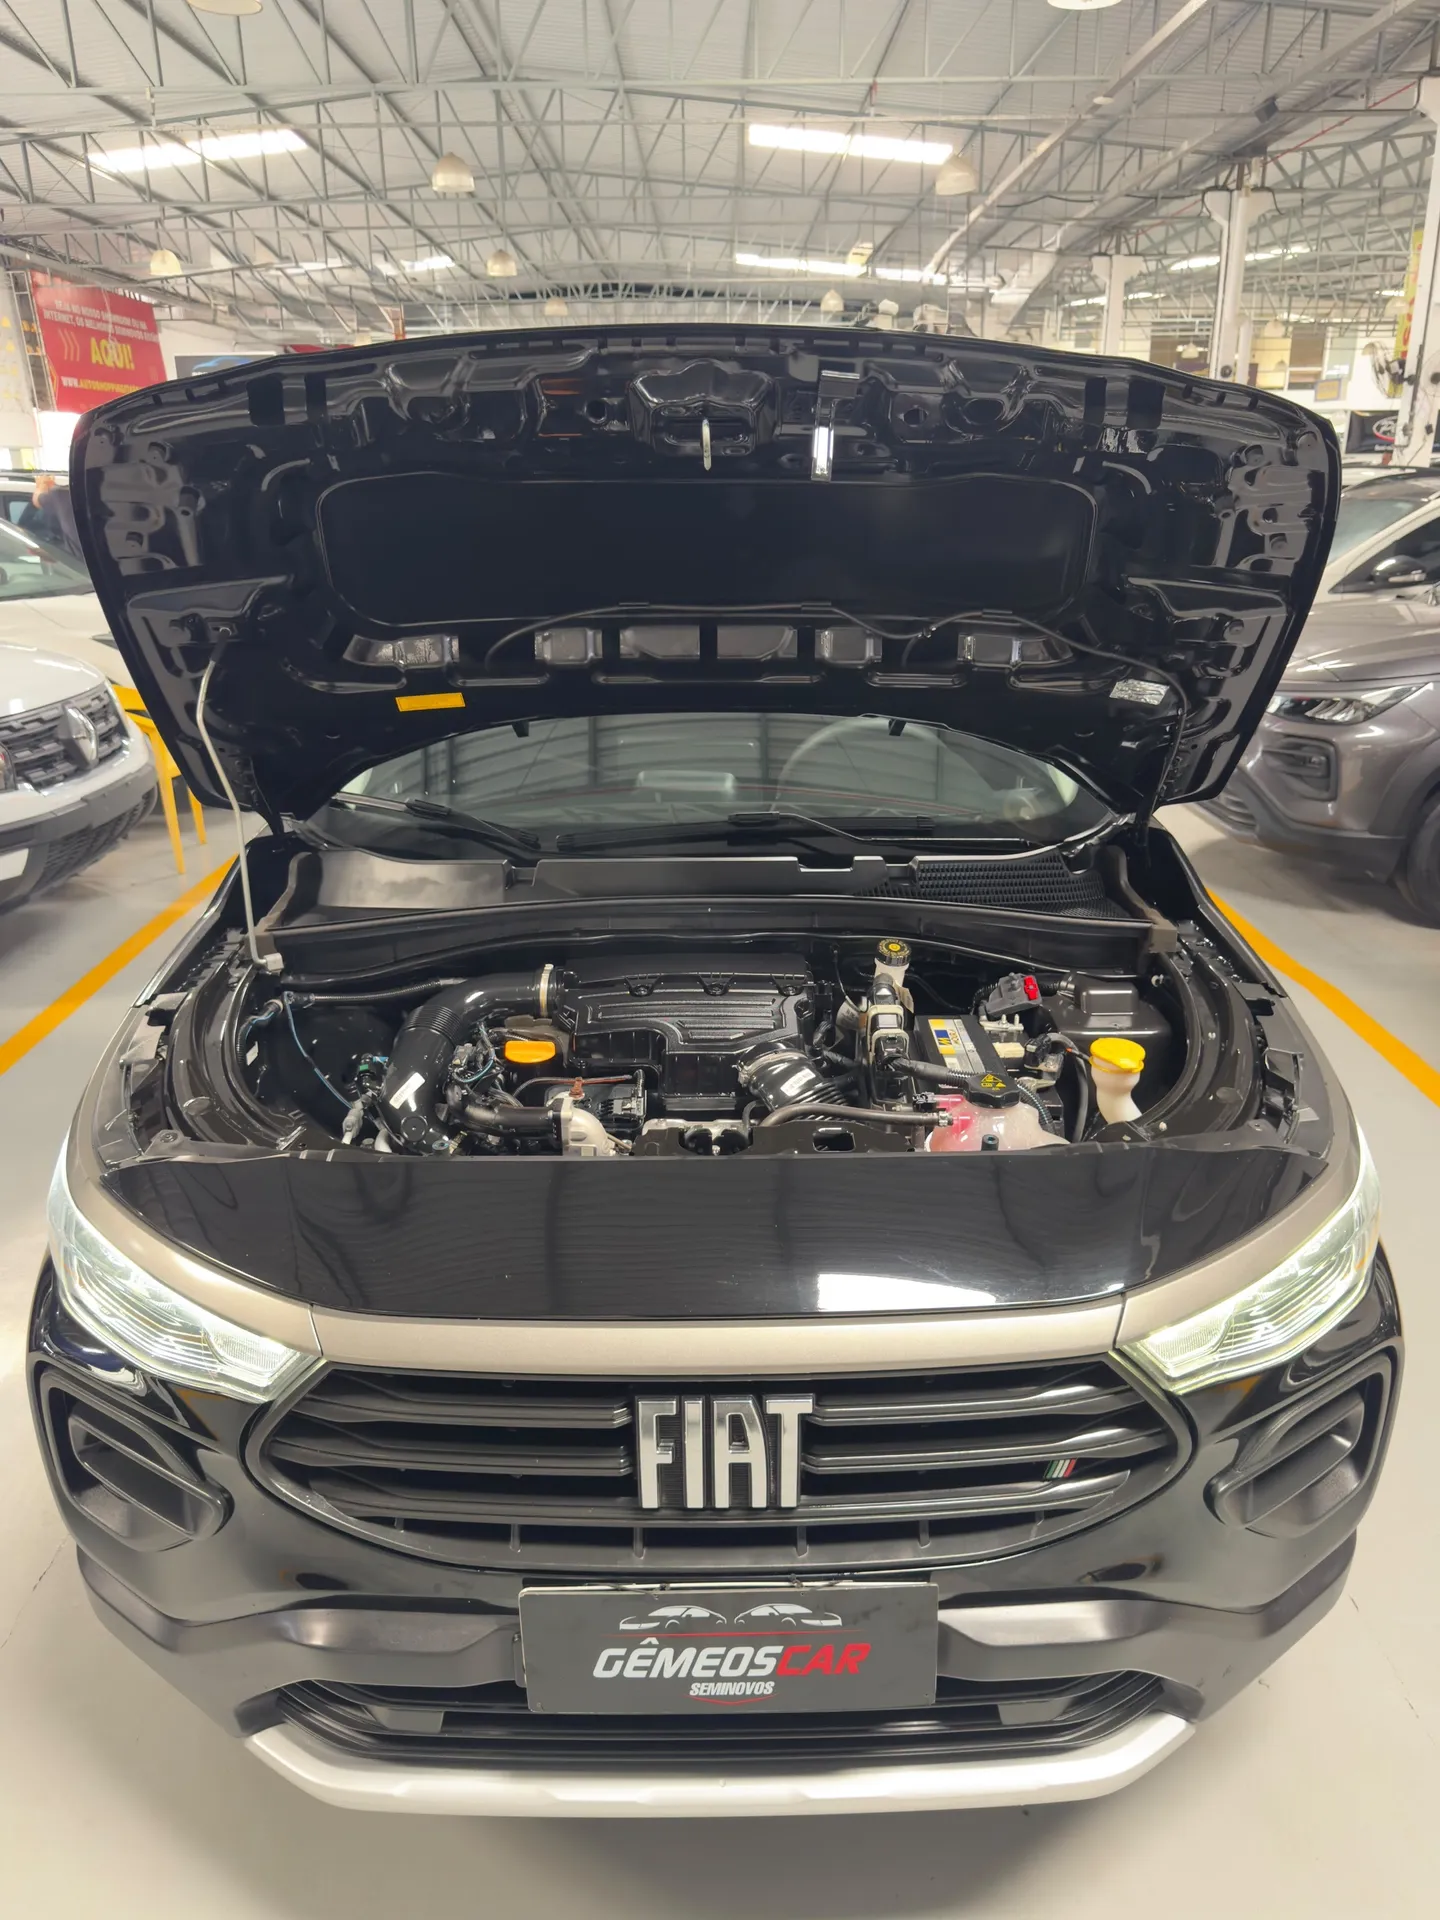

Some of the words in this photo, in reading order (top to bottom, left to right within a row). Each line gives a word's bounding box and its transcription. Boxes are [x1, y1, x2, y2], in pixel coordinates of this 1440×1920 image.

[90, 336, 135, 370] AQUI!
[637, 1398, 813, 1509] FIAT
[593, 1636, 872, 1679] GÊMEOSCAR
[690, 1681, 775, 1696] SEMINOVOS
